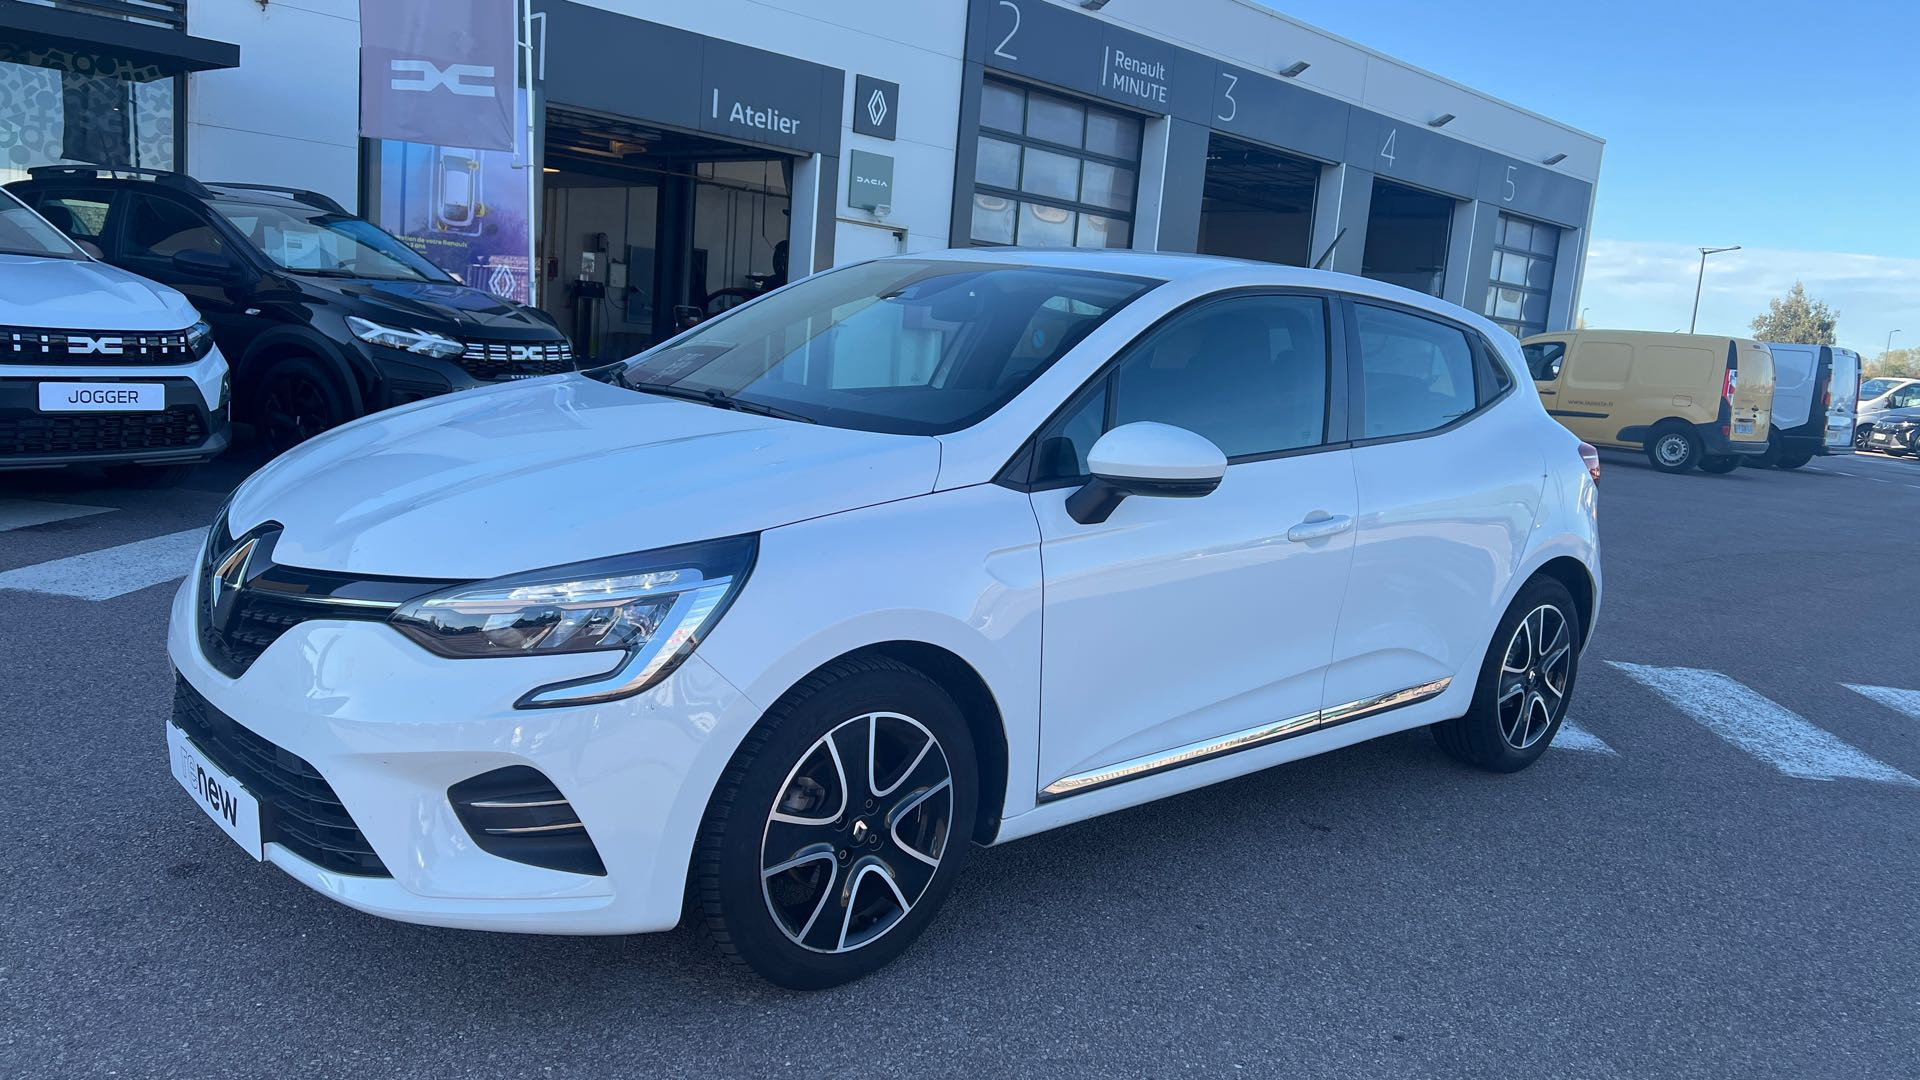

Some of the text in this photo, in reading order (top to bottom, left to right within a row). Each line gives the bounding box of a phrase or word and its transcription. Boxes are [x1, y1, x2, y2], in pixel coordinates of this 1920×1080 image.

[523, 12, 546, 80] 1
[994, 1, 1020, 60] 2
[1115, 50, 1165, 80] Renault
[1113, 73, 1167, 103] MINUTE
[1218, 73, 1238, 121] 3
[729, 102, 800, 134] Atelier
[1381, 128, 1396, 168] 4
[856, 176, 888, 187] DACIA
[1504, 166, 1517, 201] 5
[68, 390, 139, 404] JOGGER
[181, 745, 238, 828] renew
